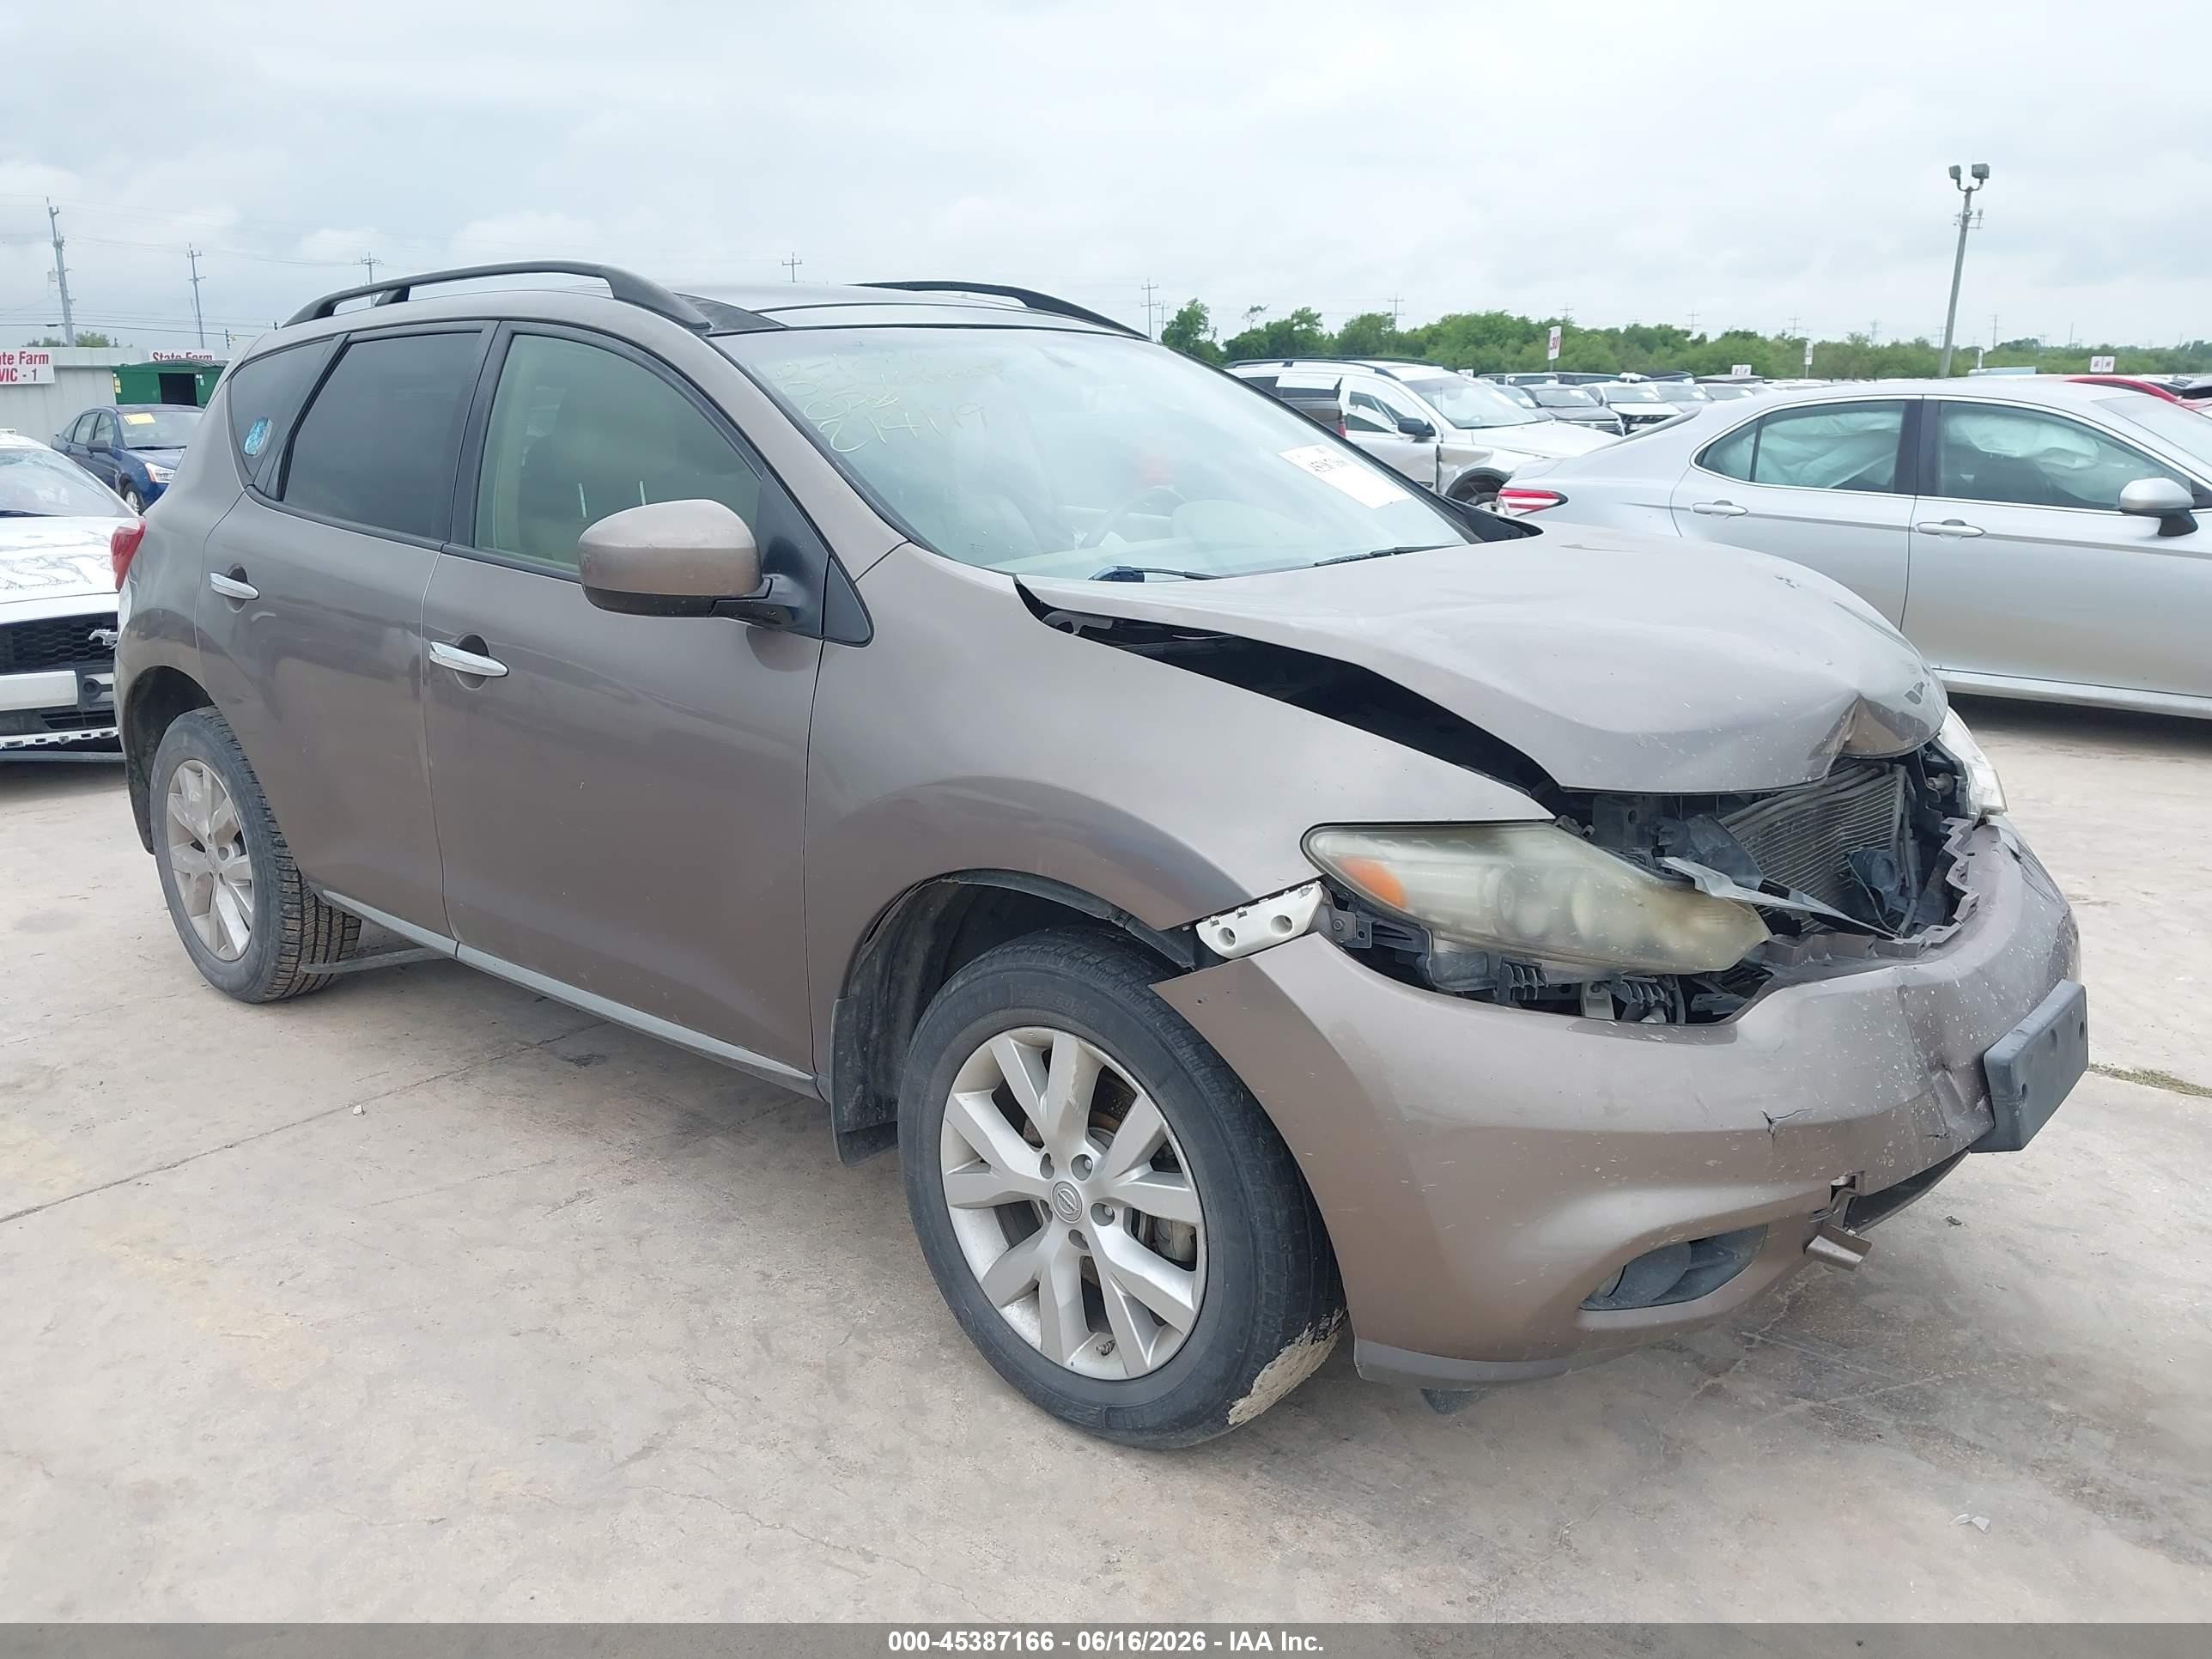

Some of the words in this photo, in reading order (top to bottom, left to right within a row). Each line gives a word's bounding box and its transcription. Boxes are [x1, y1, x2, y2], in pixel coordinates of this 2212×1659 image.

[0, 351, 15, 365] te
[19, 350, 49, 365] Farm
[31, 368, 37, 381] 1
